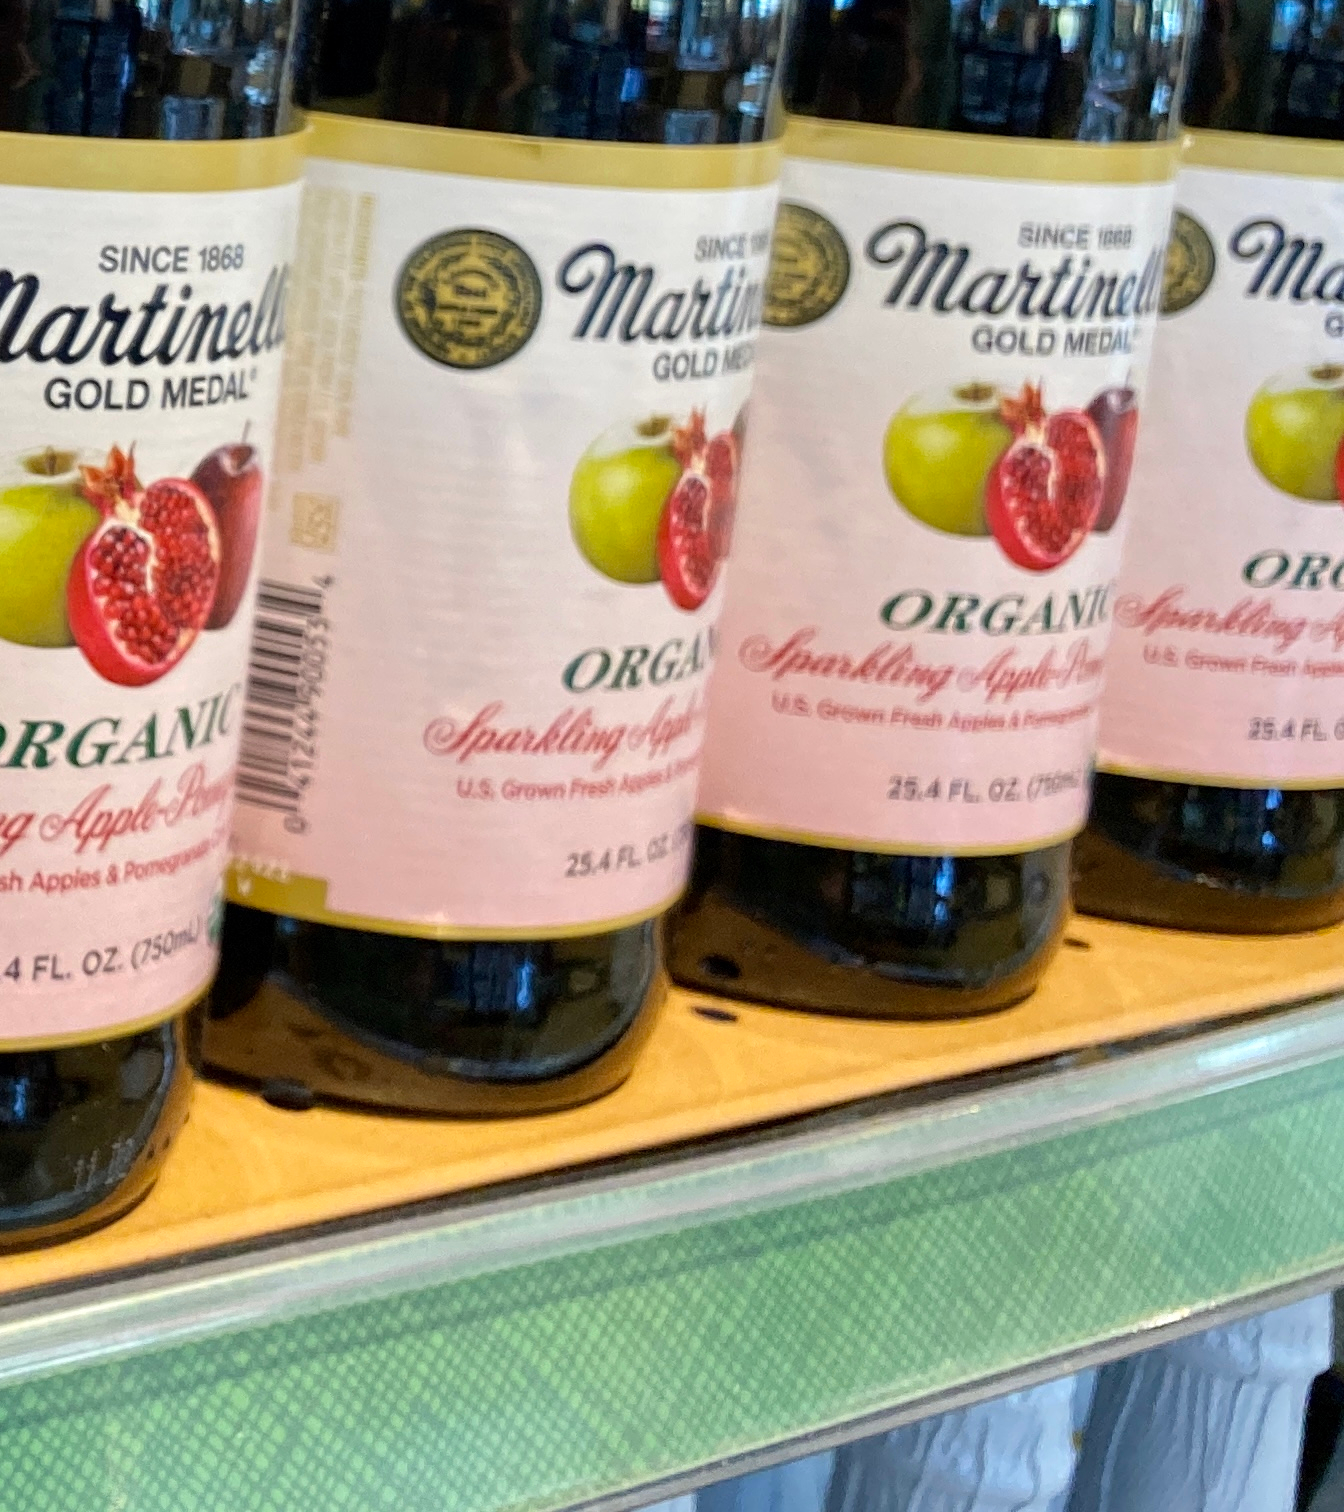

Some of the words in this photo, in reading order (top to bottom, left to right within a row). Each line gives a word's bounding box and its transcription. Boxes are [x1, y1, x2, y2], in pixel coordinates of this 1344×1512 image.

[98, 245, 189, 275] SINCE
[196, 242, 245, 271] 1868
[970, 326, 1057, 356] GOLD
[652, 352, 714, 382] GOLD
[43, 374, 151, 410] GOLD
[29, 865, 101, 896] Apples
[30, 954, 71, 982] FL.
[81, 947, 122, 977] OZ.
